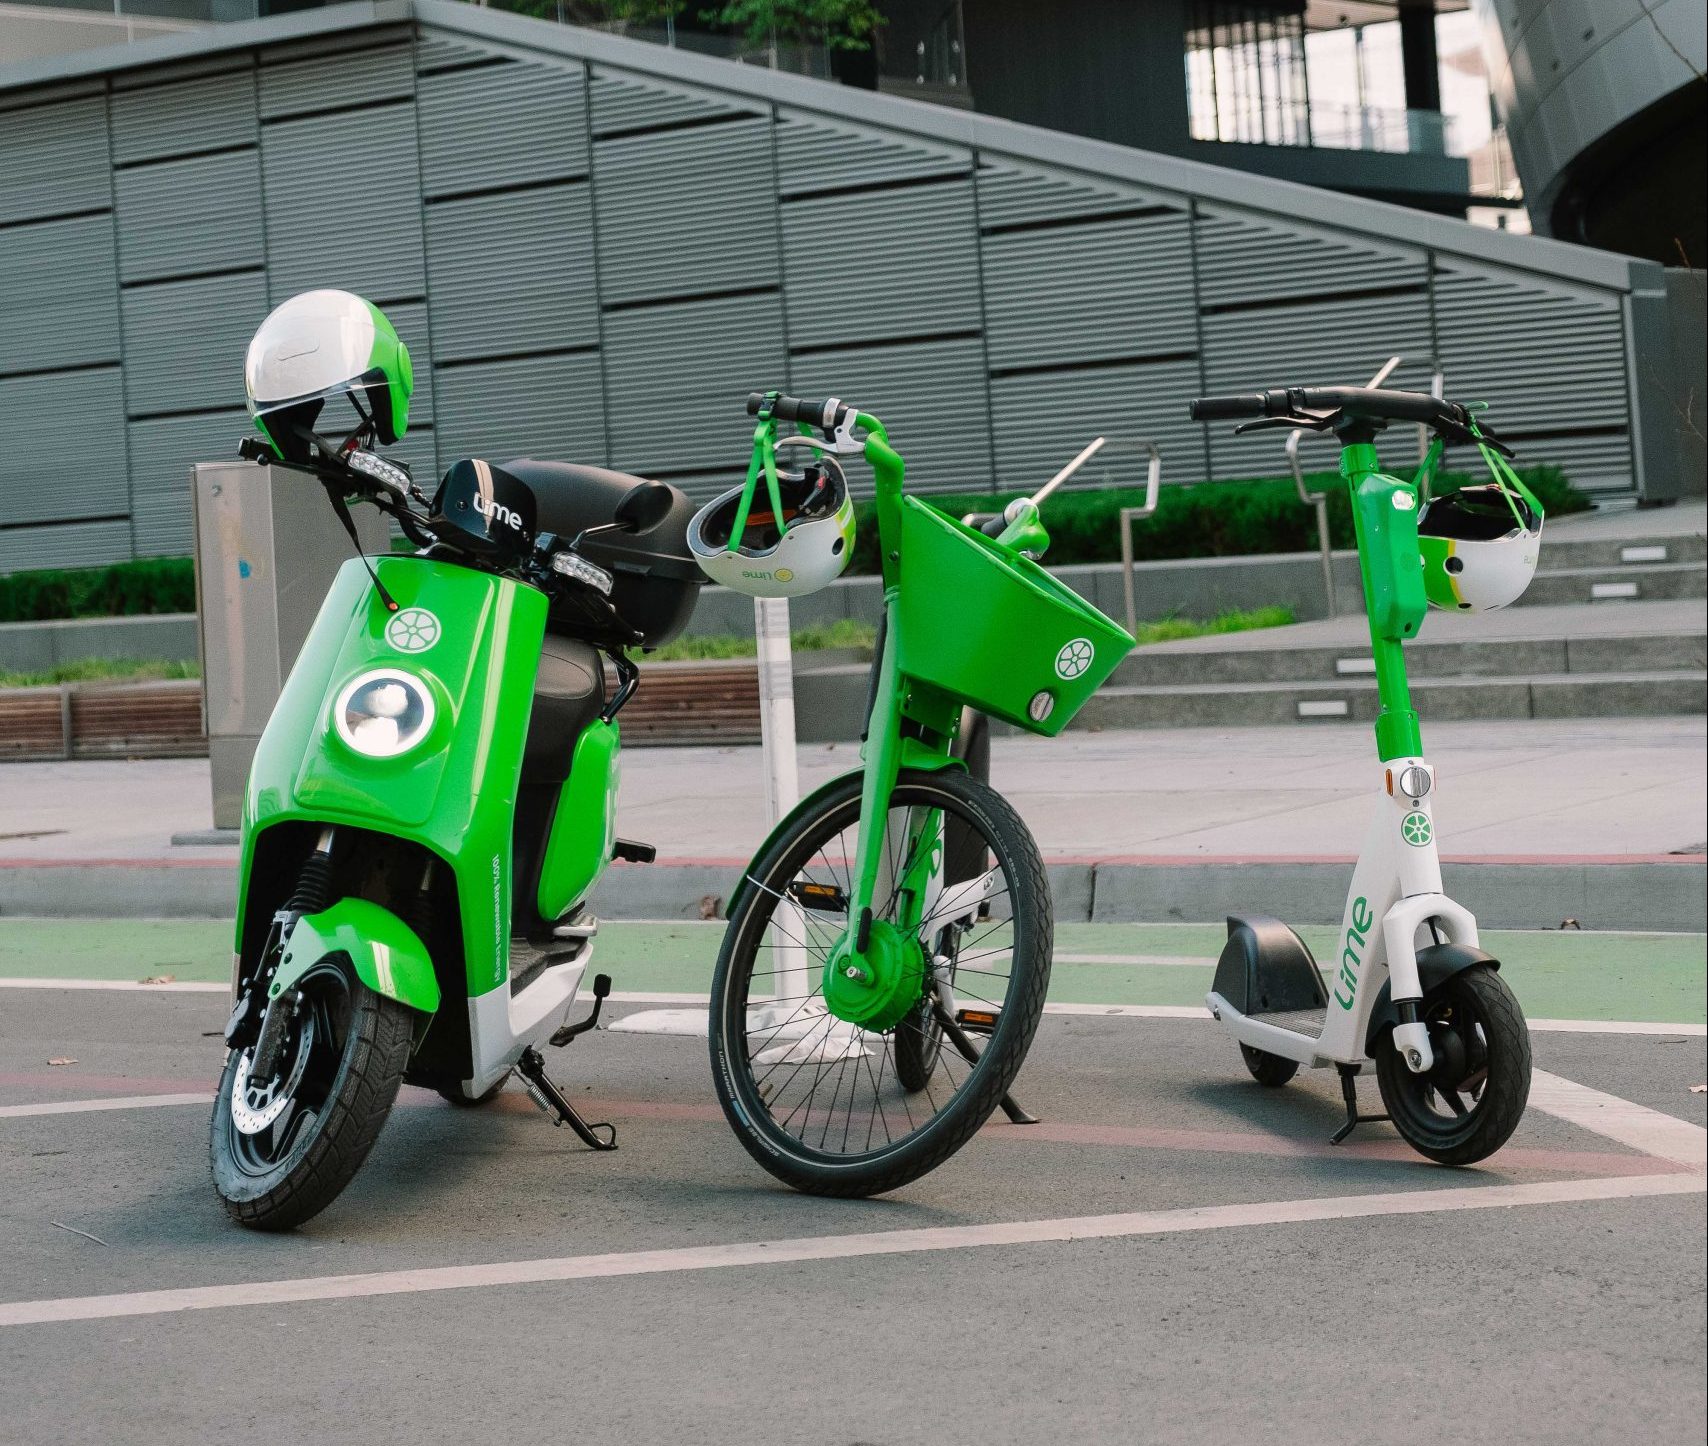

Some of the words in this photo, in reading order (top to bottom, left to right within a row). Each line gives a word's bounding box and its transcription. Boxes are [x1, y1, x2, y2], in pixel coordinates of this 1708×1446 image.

[473, 491, 522, 530] Lime
[492, 853, 500, 883] 100%
[1333, 896, 1373, 1010] Lime
